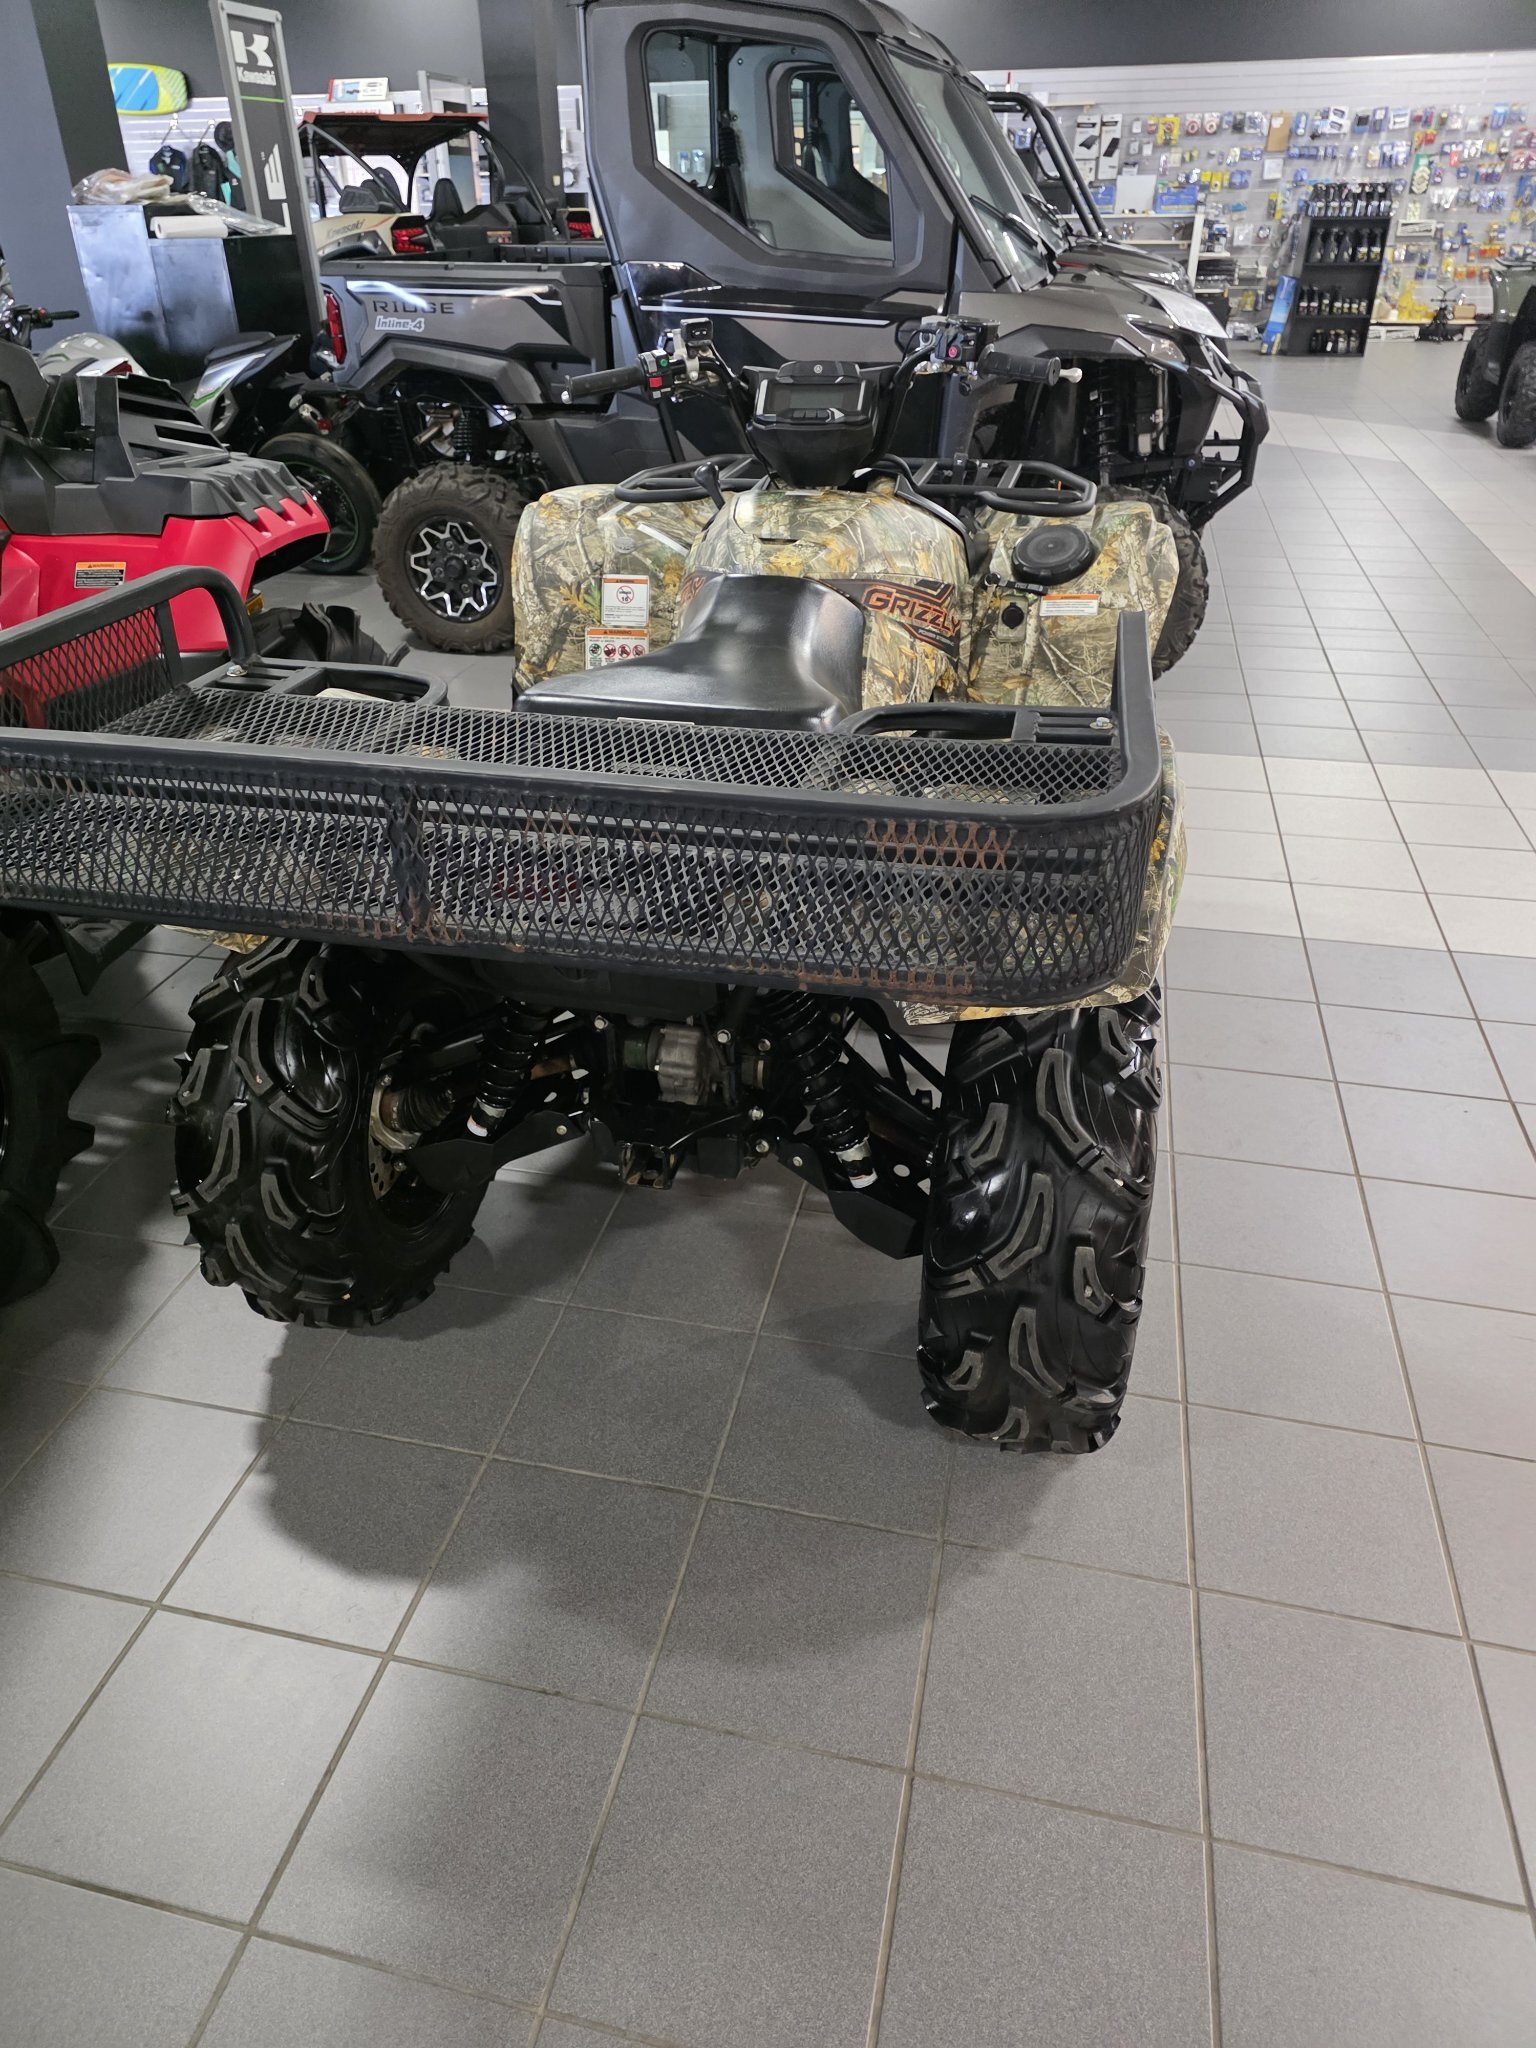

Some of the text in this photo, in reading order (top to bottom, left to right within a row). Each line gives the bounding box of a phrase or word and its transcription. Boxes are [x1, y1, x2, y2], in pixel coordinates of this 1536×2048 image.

[236, 66, 277, 86] Kawasaki
[373, 300, 454, 314] RIDGE
[376, 315, 424, 332] Inline-4
[862, 586, 960, 634] GRIZZLY
